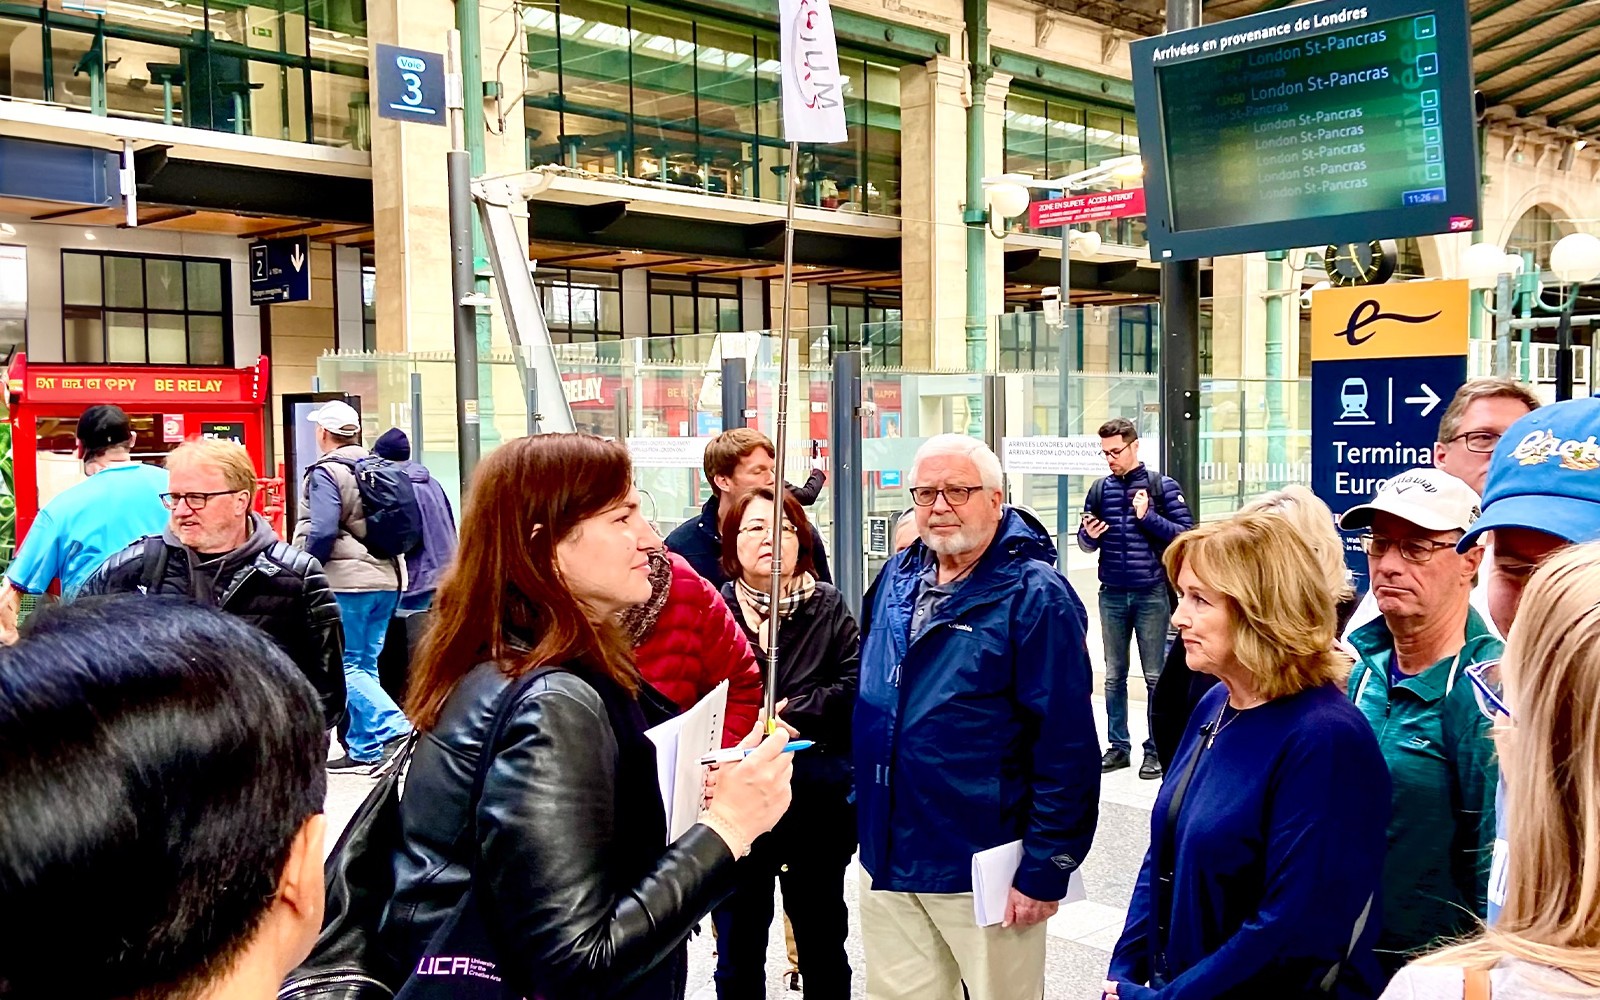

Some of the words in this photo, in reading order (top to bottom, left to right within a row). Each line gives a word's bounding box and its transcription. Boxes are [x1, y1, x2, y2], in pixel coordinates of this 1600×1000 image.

[1153, 41, 1200, 62] Arrivées
[1202, 39, 1217, 52] en
[1220, 24, 1291, 50] provenance
[1294, 18, 1311, 32] de
[1313, 6, 1369, 28] Londres
[1249, 45, 1301, 66] London
[1305, 30, 1387, 56] St-Pancras
[401, 59, 422, 69] Voie
[401, 72, 423, 106] 3
[1251, 82, 1304, 101] London
[1307, 67, 1389, 91] St-Pancras
[1254, 118, 1296, 133] London
[1299, 107, 1363, 126] St-Pancras
[1255, 135, 1297, 150] London
[1300, 125, 1364, 143] St-Pancras
[1257, 152, 1299, 167] London
[1302, 142, 1366, 160] St-Pancras
[1258, 169, 1300, 184] London
[1303, 160, 1367, 177] St-Pancras
[1260, 186, 1302, 201] London
[1305, 177, 1368, 195] St-Pancras
[256, 260, 263, 277] 2
[154, 378, 174, 392] BE
[177, 379, 223, 392] RELAY
[1333, 441, 1433, 464] Termina
